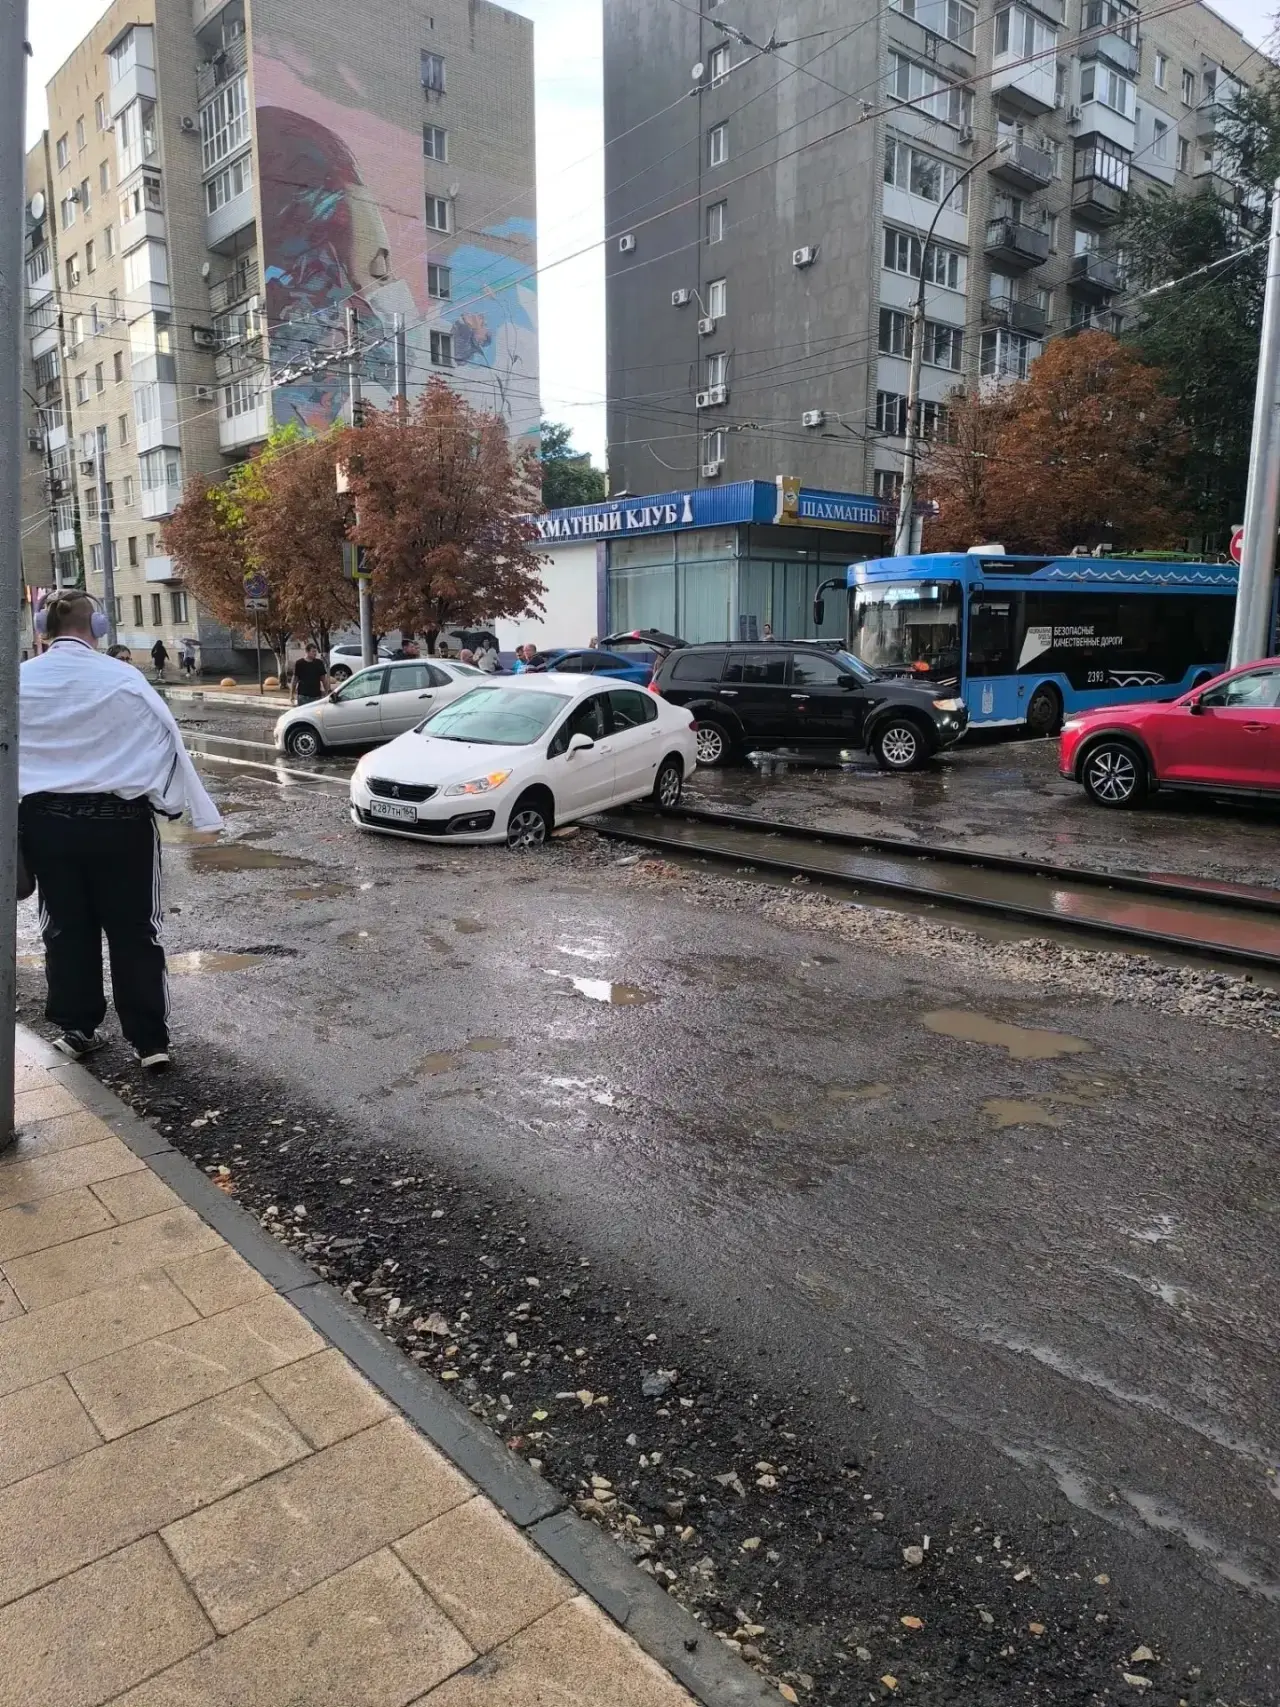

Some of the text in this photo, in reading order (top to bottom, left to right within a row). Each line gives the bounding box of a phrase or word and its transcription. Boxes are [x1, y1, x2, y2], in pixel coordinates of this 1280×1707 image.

[536, 503, 677, 538] ХМАТНЫЙ КЛУБ
[1053, 626, 1095, 636] БЕЗОПАСНЫЕ
[1053, 637, 1100, 648] КАЧЕСТВЕННЫЕ
[1100, 636, 1123, 647] ДОРОГИ
[1087, 671, 1104, 683] 2393
